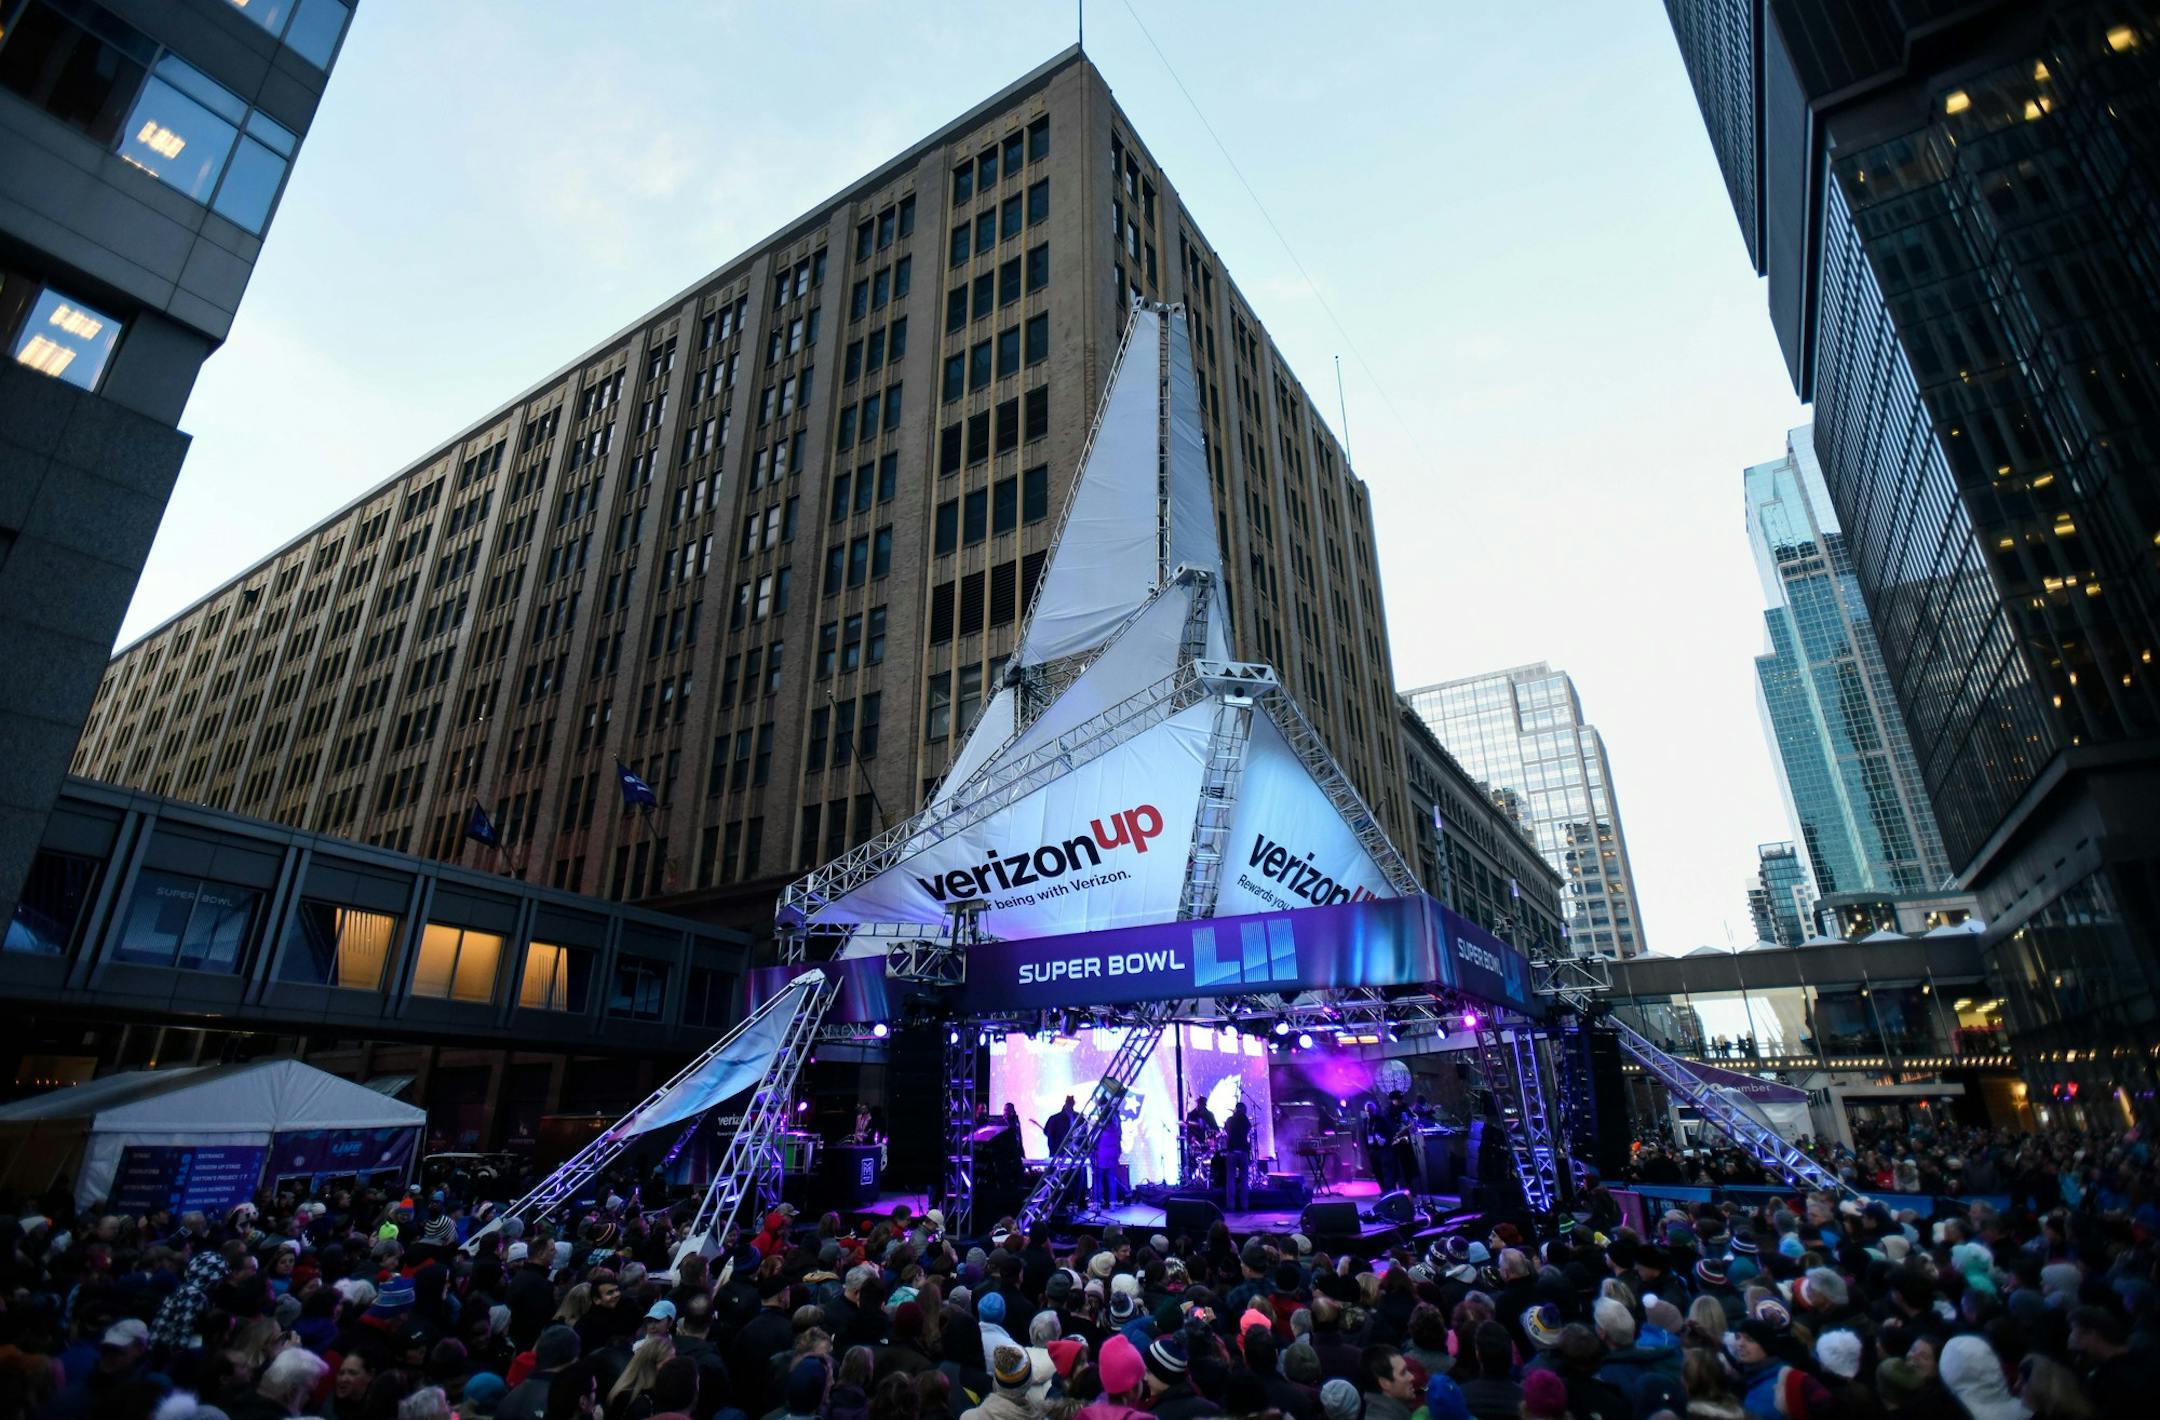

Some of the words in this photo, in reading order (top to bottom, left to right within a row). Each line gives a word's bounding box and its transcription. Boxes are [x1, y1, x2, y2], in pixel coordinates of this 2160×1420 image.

[156, 887, 196, 901] SUPER
[200, 894, 233, 907] BOWL
[995, 893, 1036, 912] being
[1037, 883, 1070, 902] with
[1070, 869, 1132, 893] Verizon.
[1237, 874, 1276, 903] Rewards
[1271, 897, 1290, 911] you
[1019, 956, 1102, 985] SUPER
[1108, 950, 1186, 977] BOWL
[1191, 918, 1299, 988] LII
[1457, 937, 1485, 968] SUPER
[1483, 950, 1504, 977] BOWL
[1734, 1083, 1771, 1094] umber
